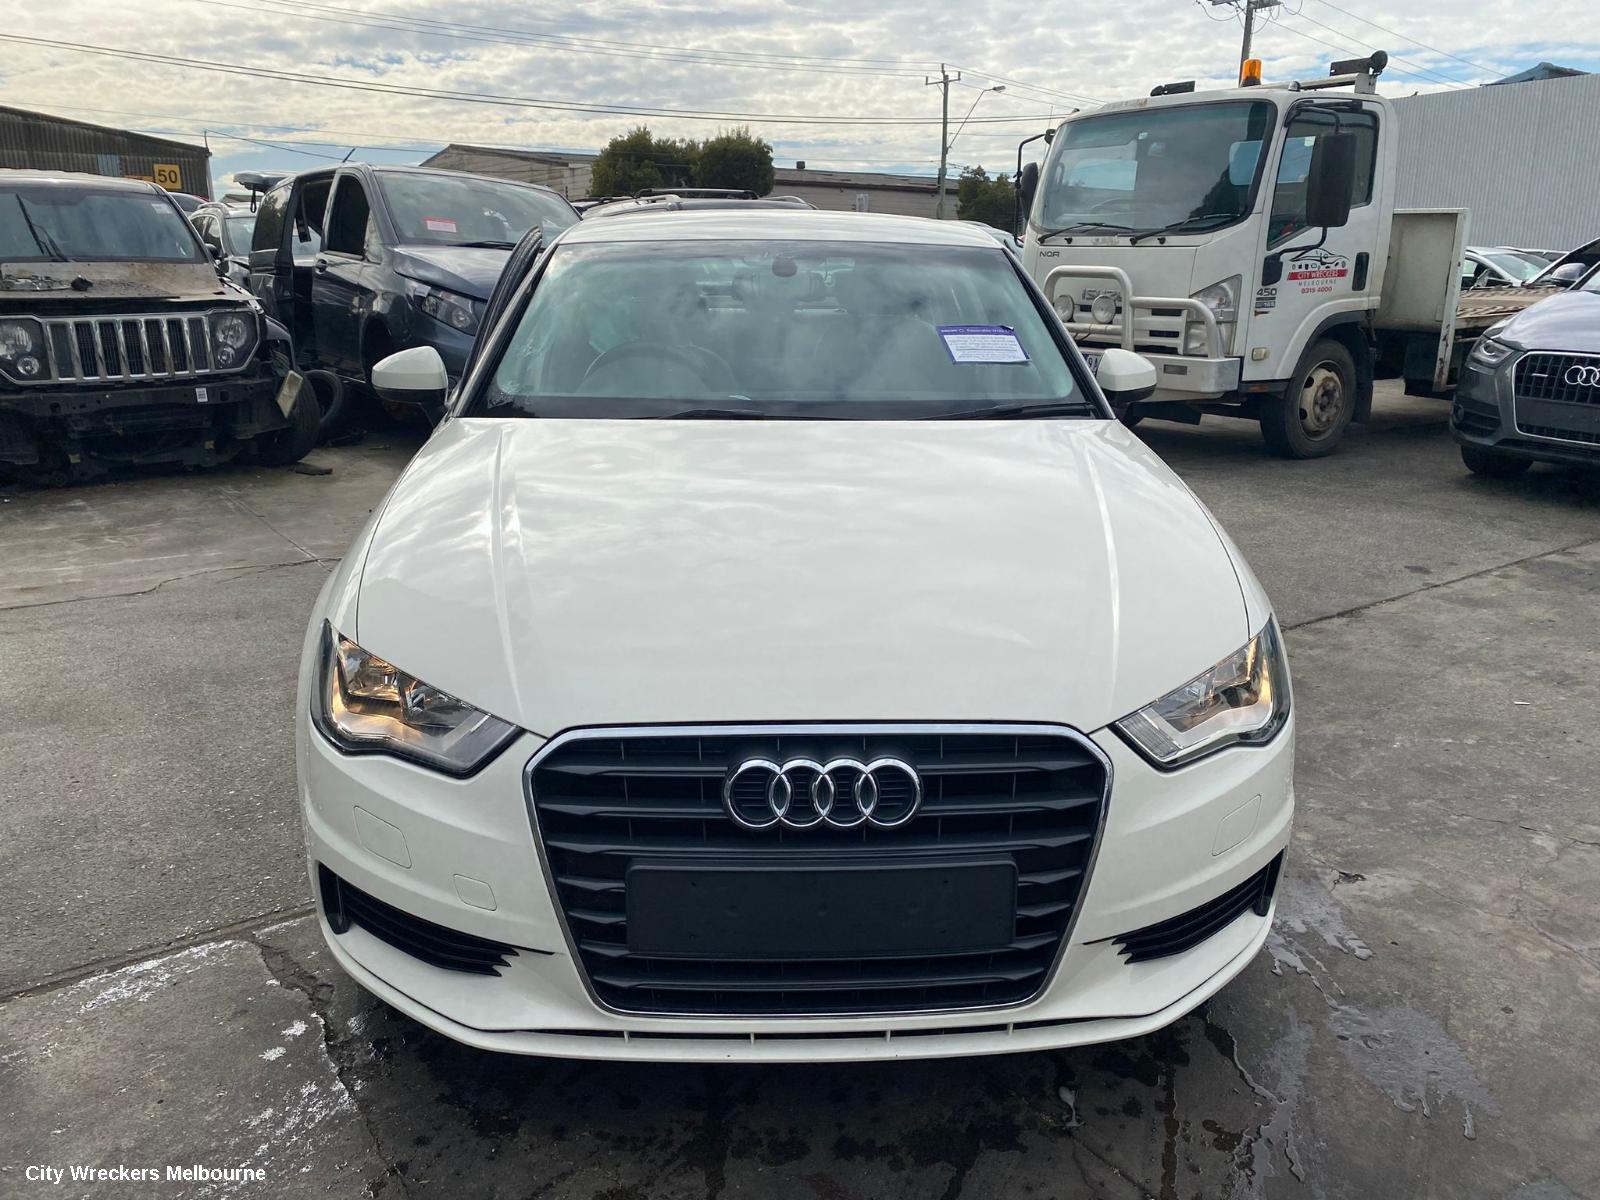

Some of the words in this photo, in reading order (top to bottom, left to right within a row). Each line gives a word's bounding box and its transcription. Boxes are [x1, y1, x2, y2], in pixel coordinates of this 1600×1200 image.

[157, 169, 178, 184] 50
[1297, 271, 1311, 279] CITY
[1311, 270, 1339, 278] WRECKERS
[1298, 279, 1337, 287] MELBOURNE
[1256, 287, 1278, 296] 450
